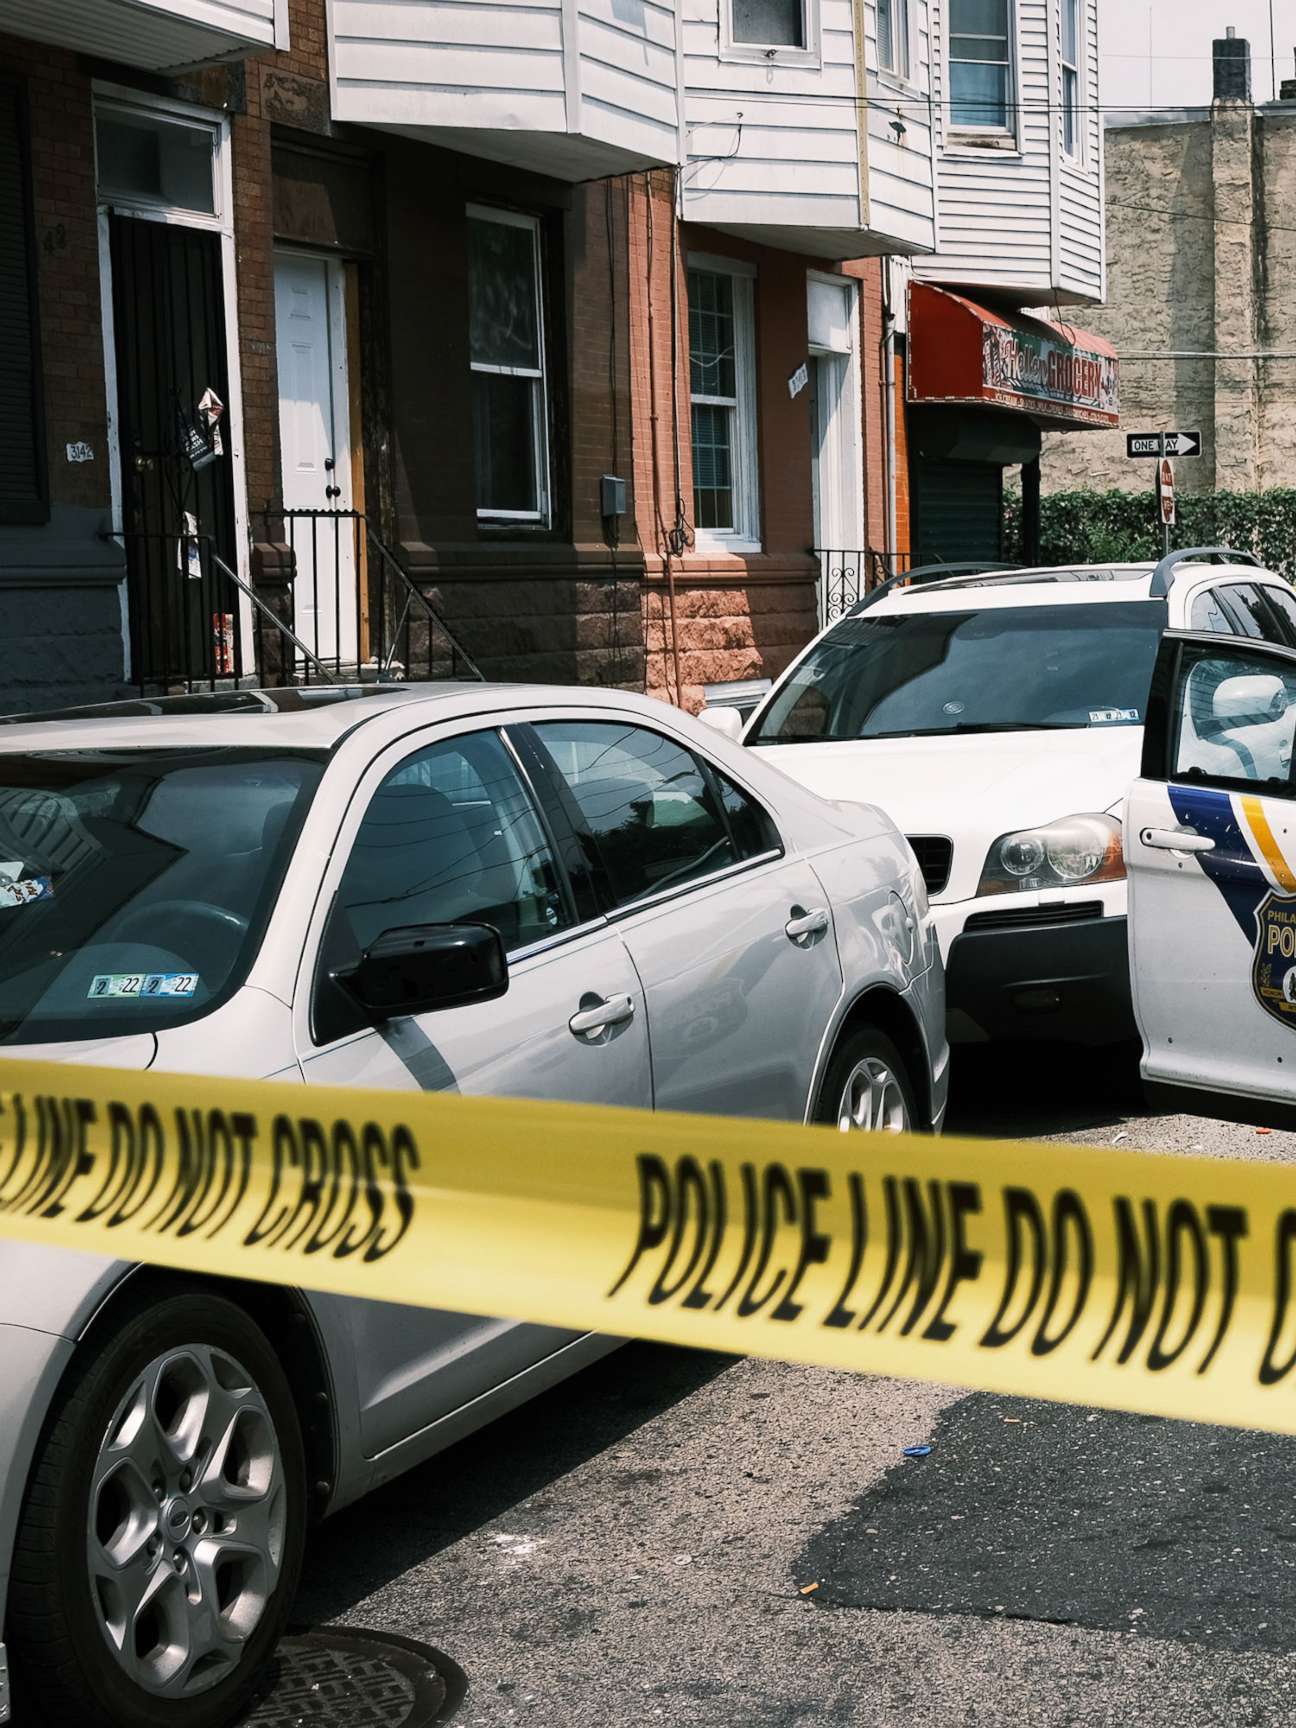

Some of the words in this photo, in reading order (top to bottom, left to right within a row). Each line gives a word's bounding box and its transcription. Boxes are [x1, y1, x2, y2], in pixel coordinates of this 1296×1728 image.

[1047, 349, 1101, 401] GROCERY
[1134, 439, 1154, 451] ONE
[1158, 439, 1178, 450] AY
[97, 981, 107, 995] 2
[122, 977, 140, 993] 22
[174, 976, 192, 993] 22
[75, 1101, 165, 1228] DO
[142, 1105, 258, 1240] NOT
[242, 1112, 421, 1263] CROSS
[607, 1152, 832, 1323] POLICE
[821, 1171, 984, 1341] LINE
[977, 1185, 1096, 1358] DO
[1089, 1194, 1249, 1375] NOT
